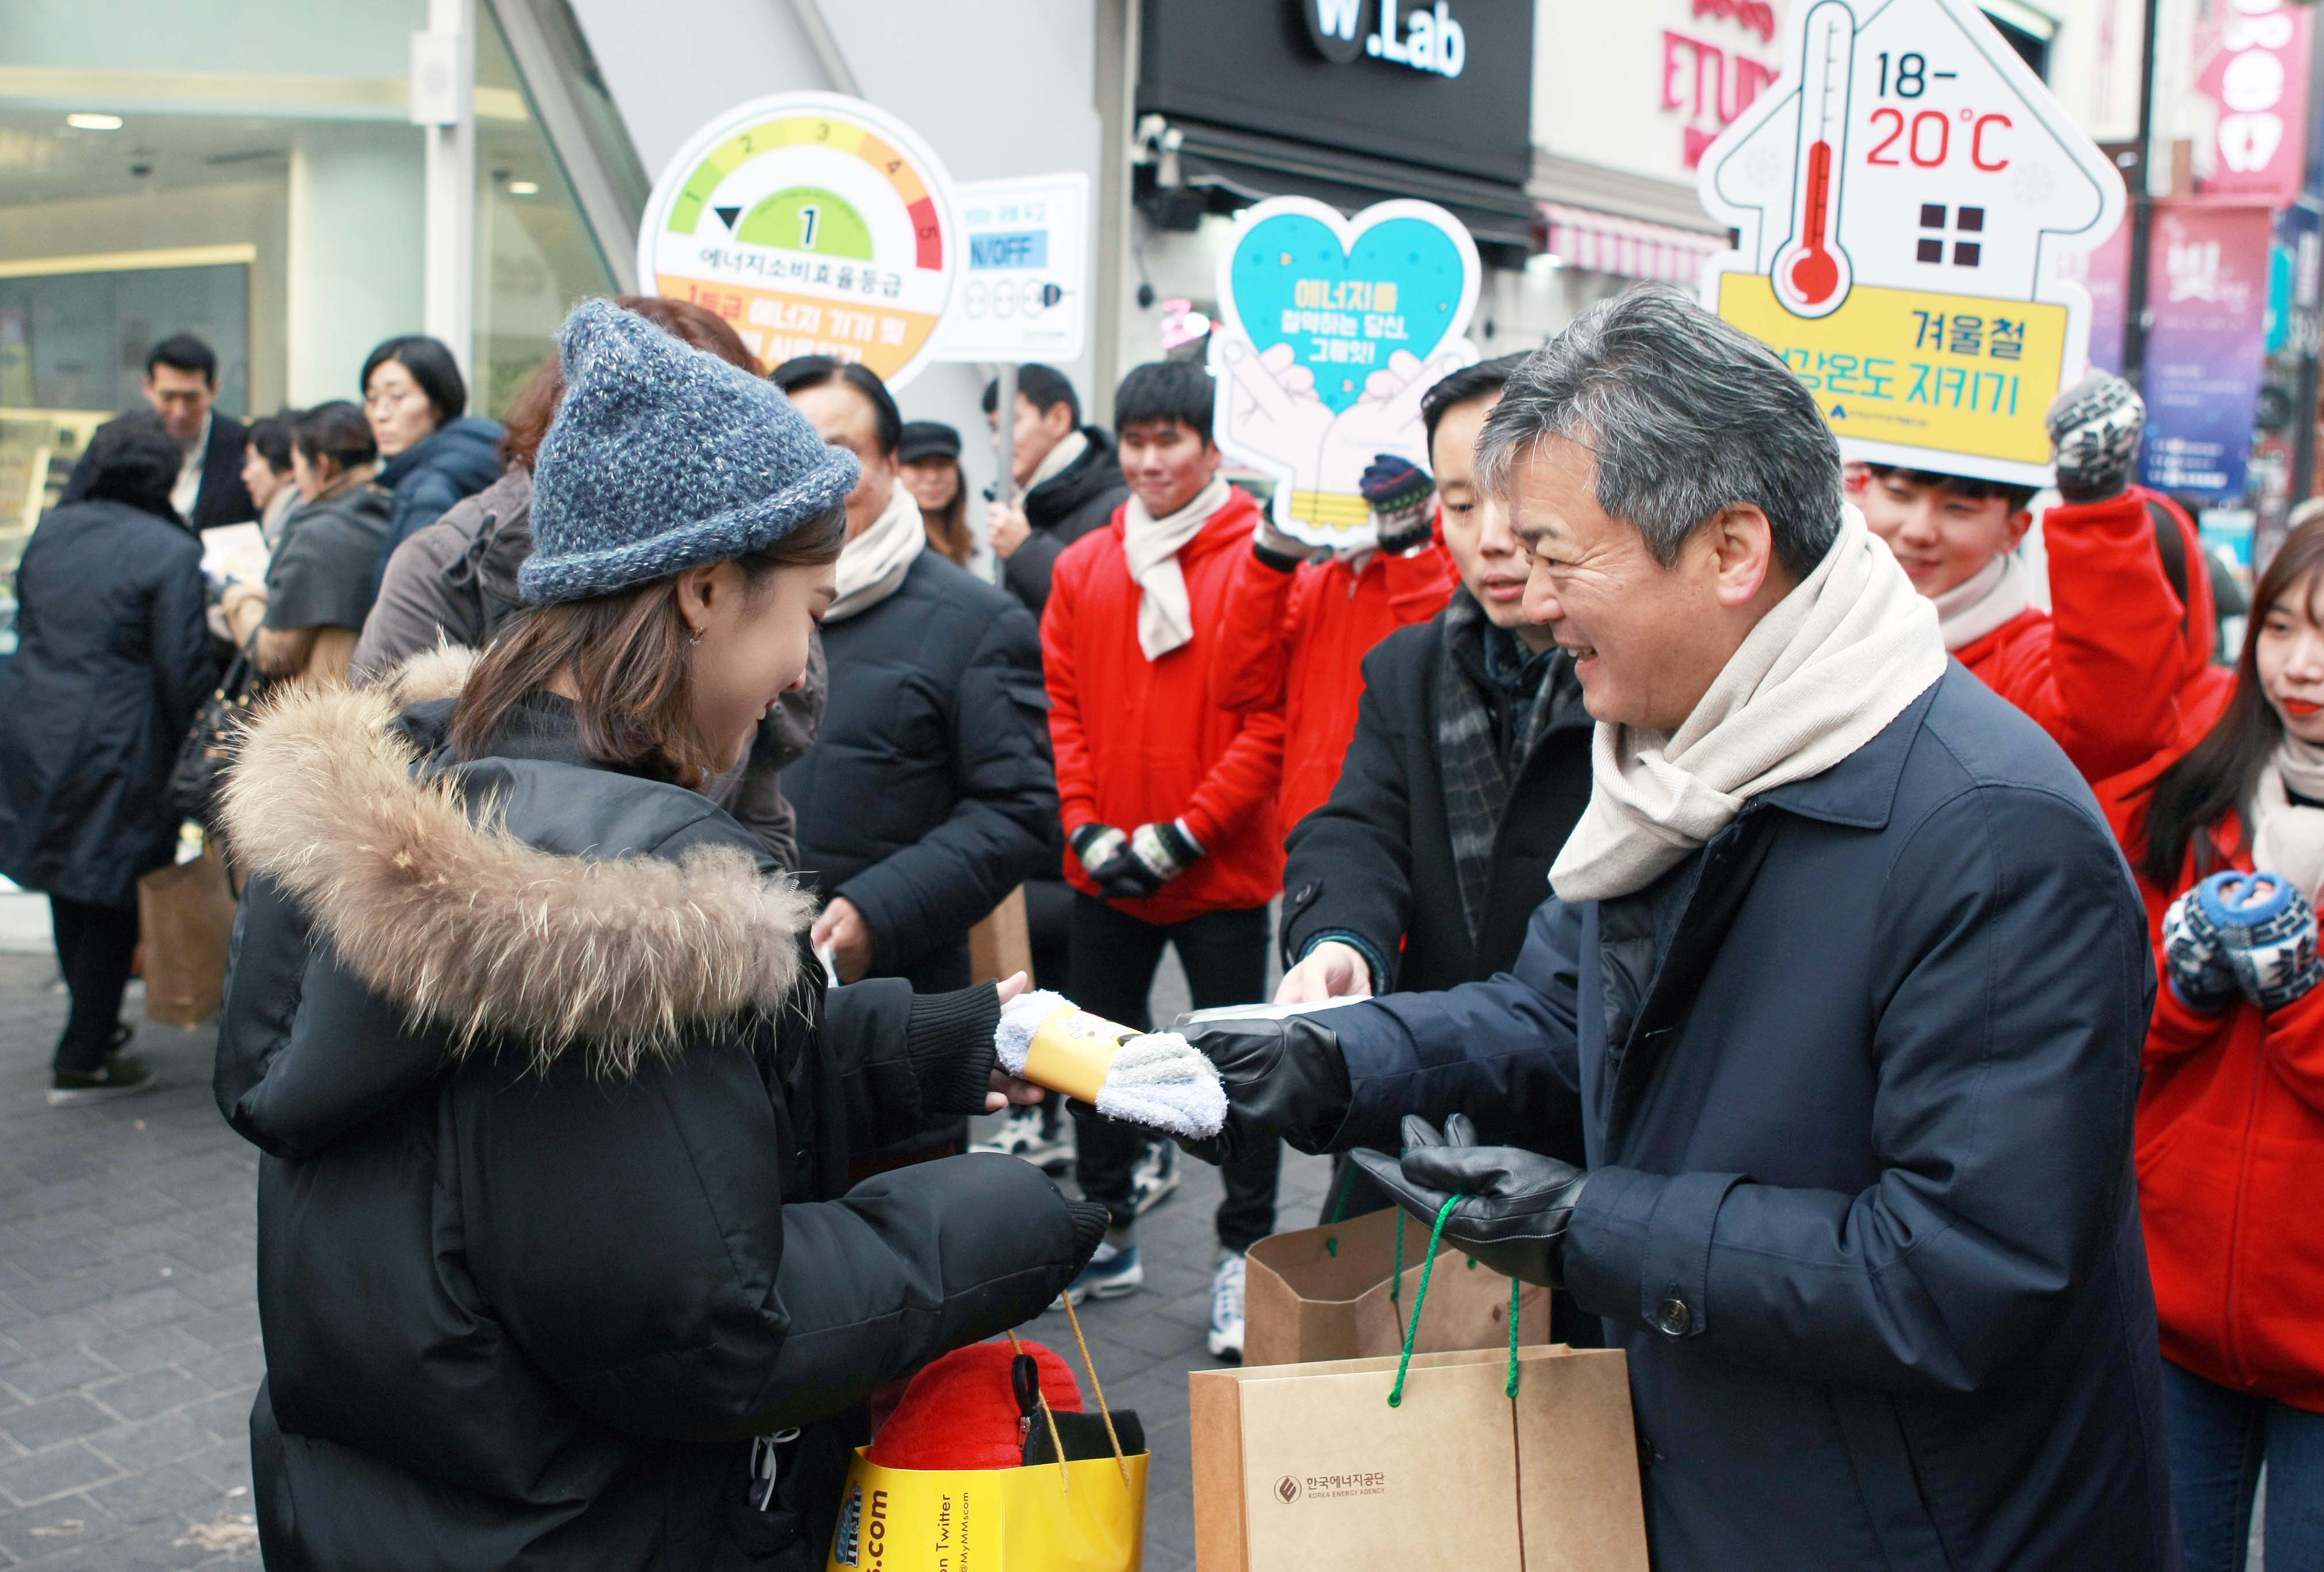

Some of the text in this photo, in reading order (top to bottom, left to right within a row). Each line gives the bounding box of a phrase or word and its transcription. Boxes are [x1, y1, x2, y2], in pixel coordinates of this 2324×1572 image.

[740, 135, 755, 154] 2
[817, 123, 831, 141] 3
[886, 159, 901, 175] 4
[920, 225, 937, 240] 5
[804, 209, 816, 244] 1
[699, 246, 903, 298] 에너지소비효율등급
[1294, 278, 1398, 313] 에너지를
[749, 296, 823, 338] 에너지
[827, 307, 877, 345] 기기
[1912, 309, 2025, 361] 겨울철
[1906, 362, 2019, 416] 지키기
[1306, 1472, 1385, 1490] 한국에너지공단
[1332, 1490, 1358, 1498] ENERGY
[936, 1494, 951, 1552] Twitter
